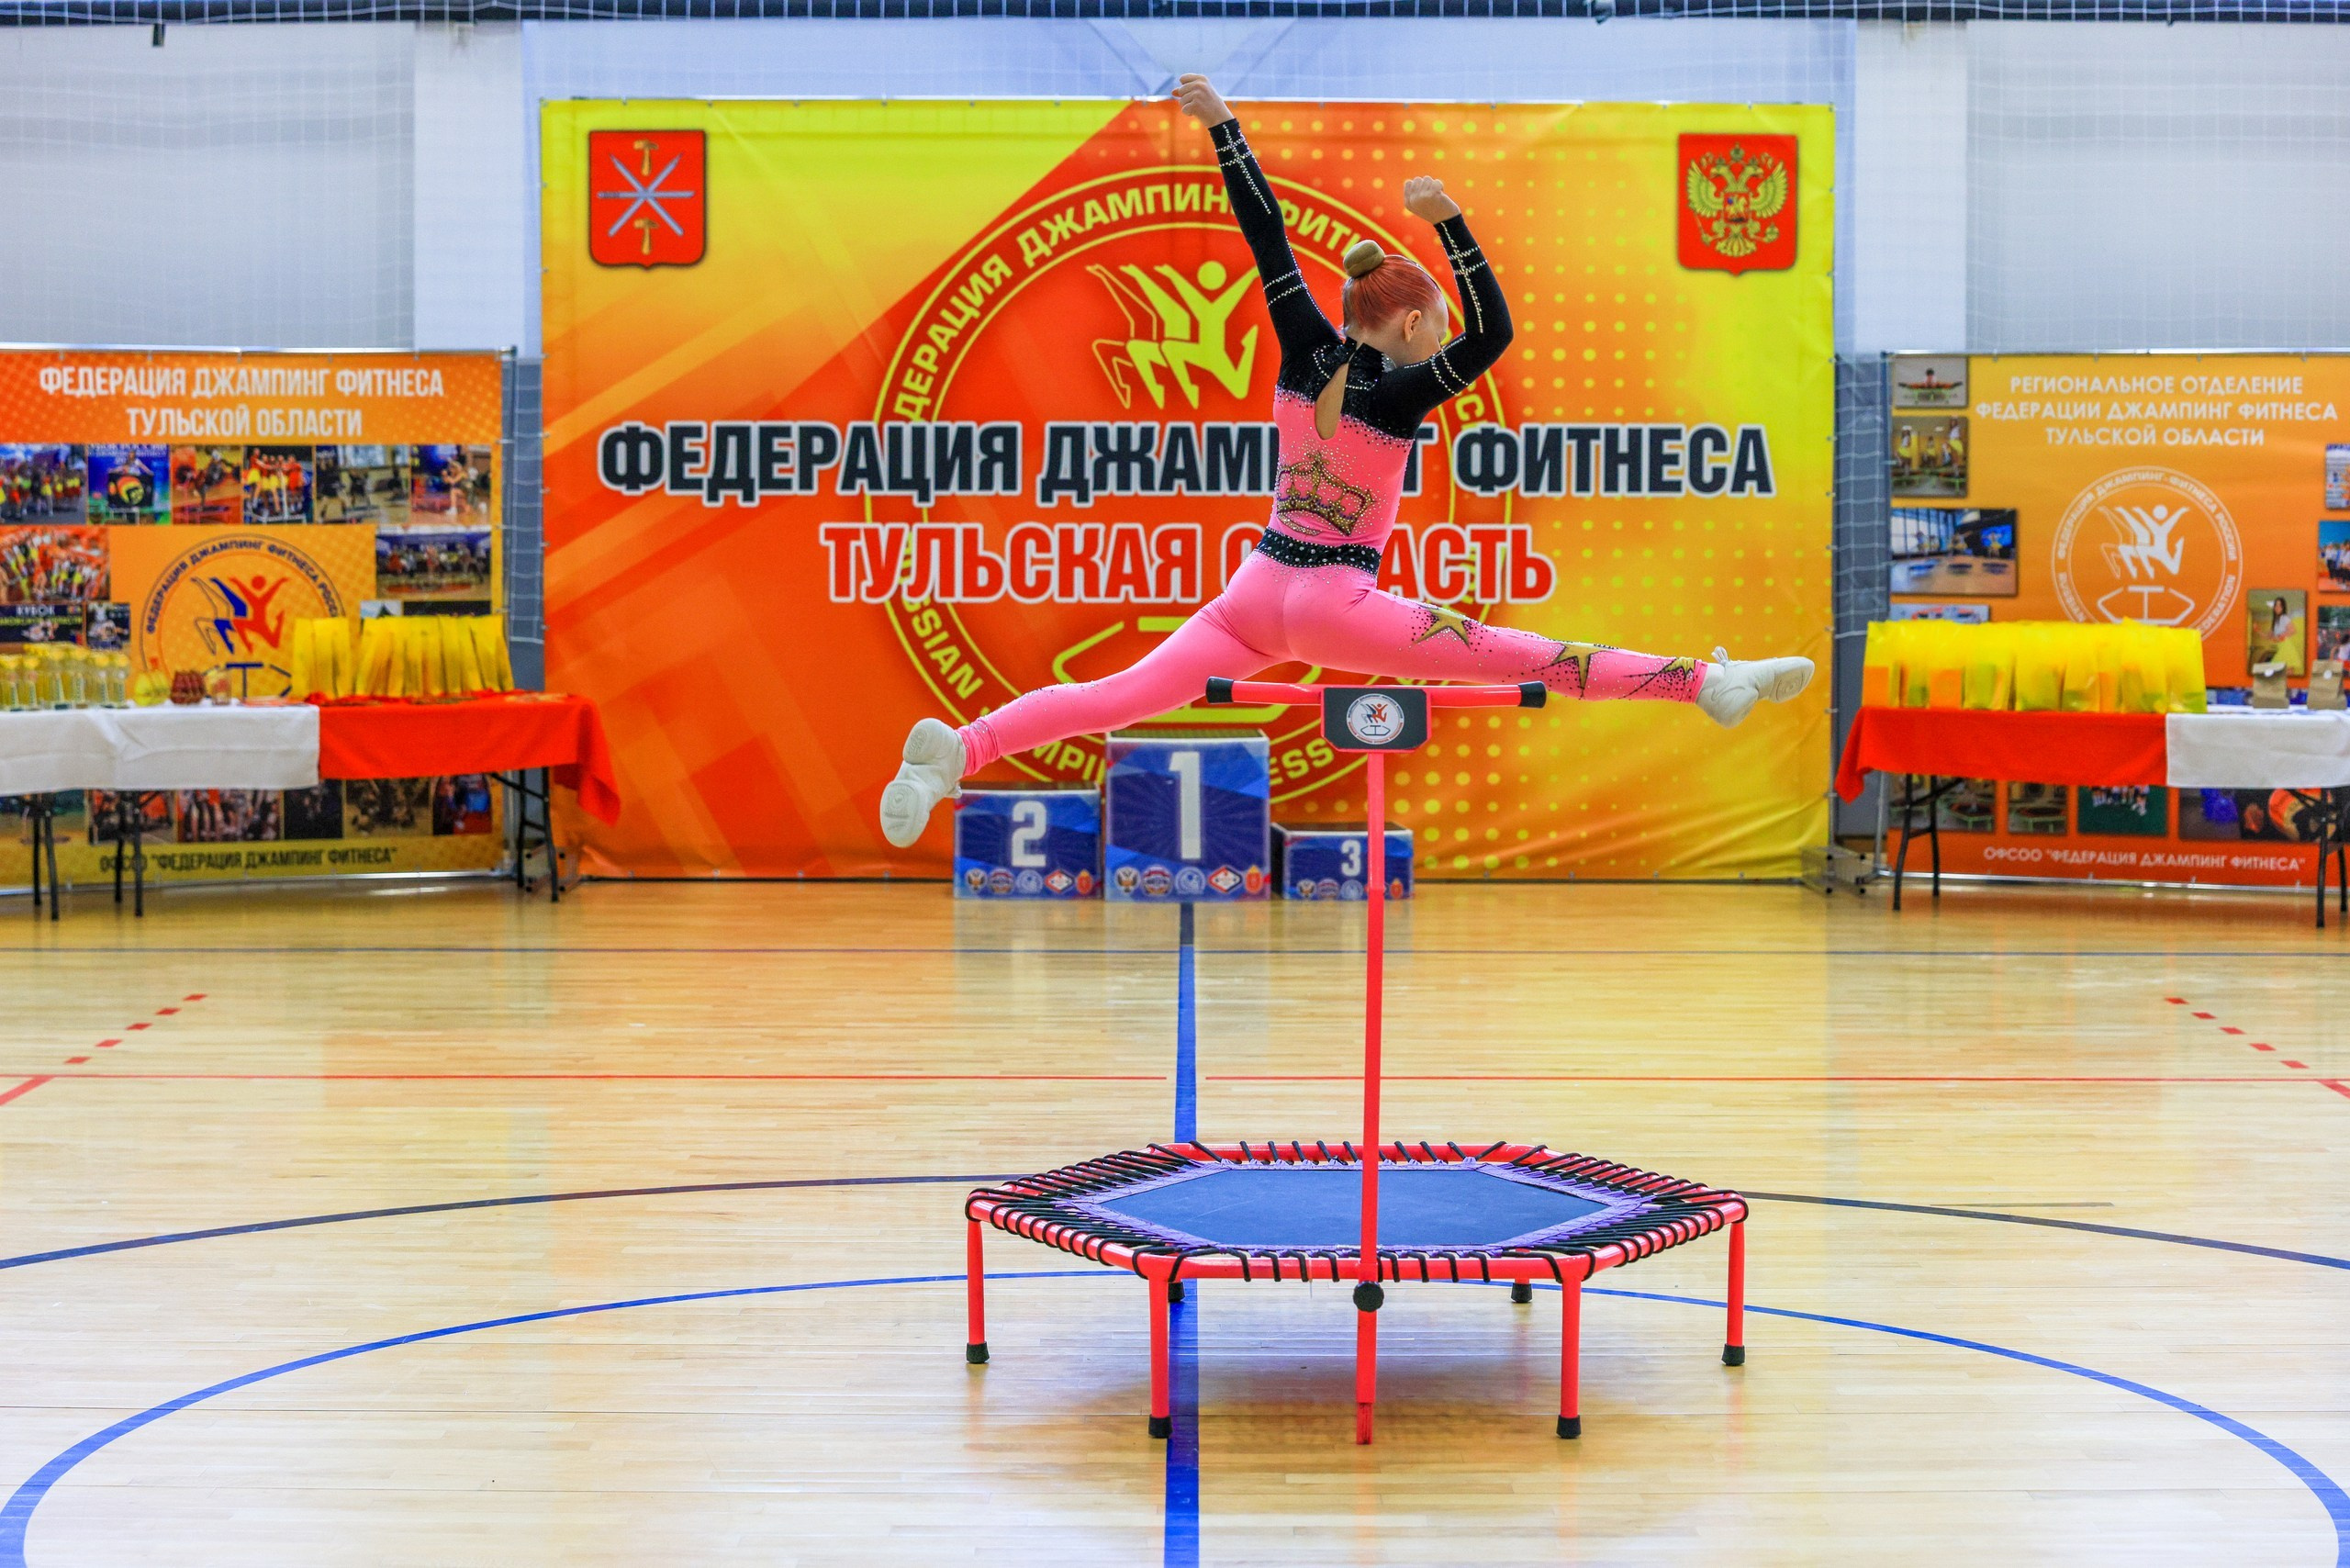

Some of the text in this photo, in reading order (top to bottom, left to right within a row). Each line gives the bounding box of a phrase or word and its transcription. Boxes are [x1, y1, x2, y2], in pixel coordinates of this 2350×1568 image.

[893, 253, 1013, 423] ДЕРАЦИЯ
[1016, 184, 1235, 268] ДЖАМПИН
[39, 366, 444, 398] ФЕДЕРАЦИЯ ДЖАМПИНГ ФИТНЕСА
[2010, 375, 2304, 396] РЕГИОНАЛЬНОЕ ОТДЕЛЕНИЕ
[126, 405, 362, 437] ТУЛЬСКОЙ ОБЛАСТИ
[1976, 401, 2338, 421] ФЕДЕРАЦИИ ДЖАМПИНГ ФИТНЕСА
[2046, 425, 2265, 447] ТУЛЬСКОЙ ОБЛАСТИ
[599, 420, 1775, 507] ФЕДЕРАЦИЯ ДЖАМГ ФИТНЕСА
[820, 521, 1203, 604] ТУЛЬСКАЯ
[1220, 522, 1557, 604] ОАСТЬ
[318, 582, 339, 618] РОСС
[901, 592, 985, 700] SIAN
[1168, 751, 1201, 860] 1
[1012, 801, 1047, 868] 2
[245, 848, 324, 869] ДЖАМПИНГ
[1340, 839, 1361, 877] 3
[1983, 846, 2307, 871] ОФСОО "ФЕДЕРАЦИЯ ДЖАМПИНГ ФИТНЕСА"
